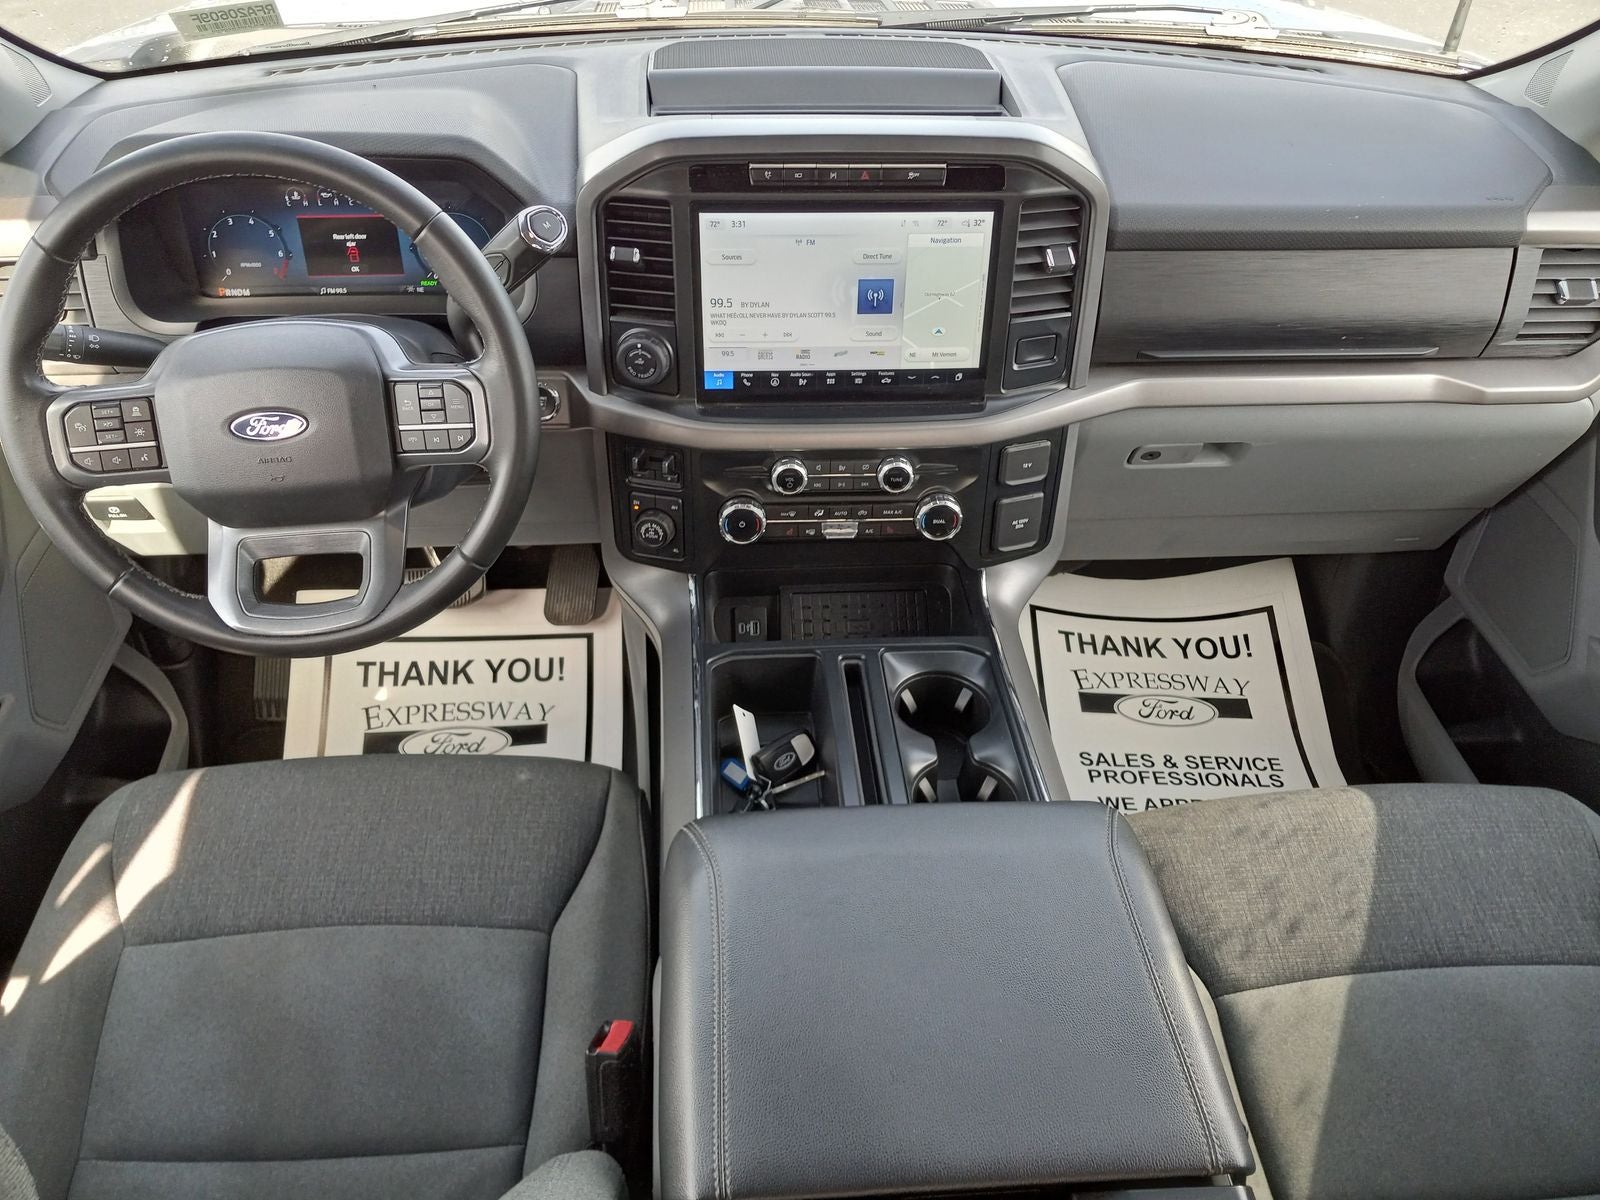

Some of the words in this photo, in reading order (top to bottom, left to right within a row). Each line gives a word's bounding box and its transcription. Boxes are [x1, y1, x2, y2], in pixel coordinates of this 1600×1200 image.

[227, 217, 234, 226] 3
[248, 217, 255, 225] 4
[731, 220, 746, 229] 3:31
[212, 230, 218, 238] 2
[268, 229, 275, 238] 5
[930, 236, 962, 247] Navigation
[277, 249, 284, 258] 6
[721, 253, 743, 261] Sources
[862, 252, 878, 260] Direct
[879, 252, 893, 260] Tune
[225, 268, 232, 276] 0
[710, 297, 733, 309] 99.5
[741, 301, 749, 309] BY
[749, 301, 770, 309] DYLAN
[826, 371, 837, 379] Apps
[1058, 630, 1168, 659] THANK
[1171, 633, 1254, 660] YOU!
[356, 659, 475, 688] THANK
[484, 656, 566, 684] YOU!
[1070, 668, 1250, 697] EXPRESSWAY
[1138, 698, 1195, 721] Ford
[361, 700, 556, 731] EXPRESSWAY
[423, 731, 487, 755] Ford
[1079, 751, 1155, 768] SALES
[1162, 754, 1179, 769] &
[1184, 755, 1285, 772] SERVICE
[1087, 769, 1285, 789] PROFESSIONALS
[1097, 795, 1138, 811] WE
